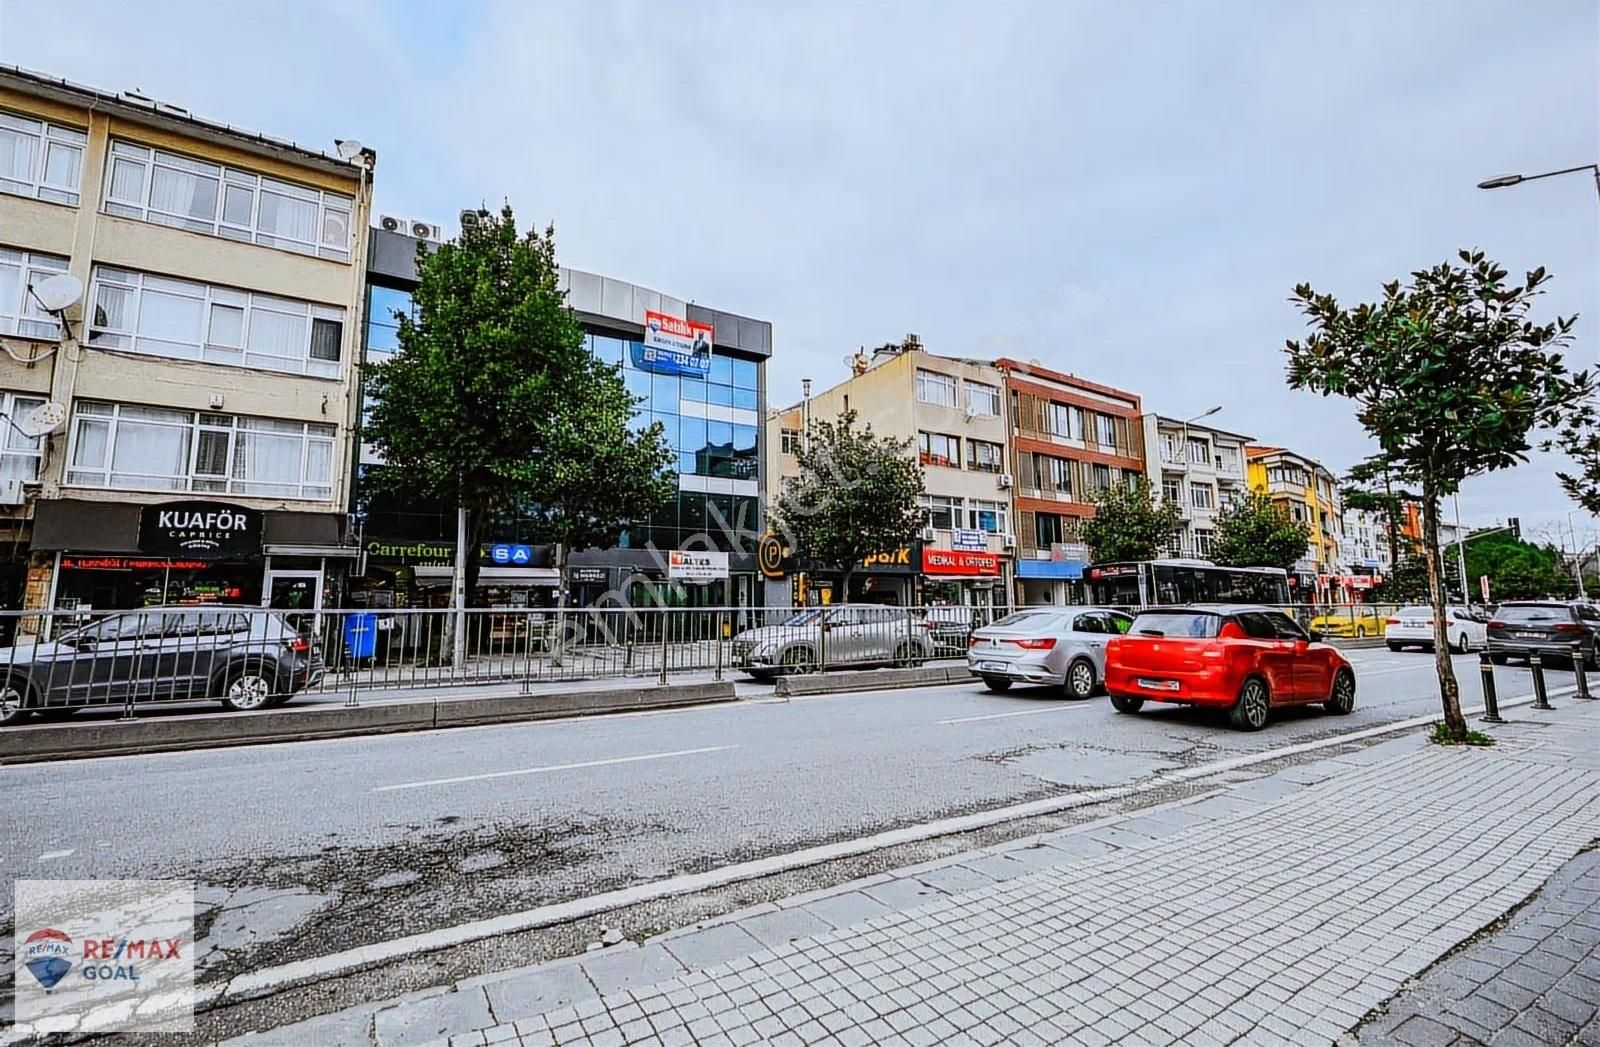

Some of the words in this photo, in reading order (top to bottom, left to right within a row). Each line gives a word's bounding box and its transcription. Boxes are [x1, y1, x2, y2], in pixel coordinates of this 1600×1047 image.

[159, 509, 247, 530] KUAFÖR
[169, 530, 231, 539] CAPRICE
[367, 541, 451, 558] Carrefour
[494, 548, 529, 560] SA
